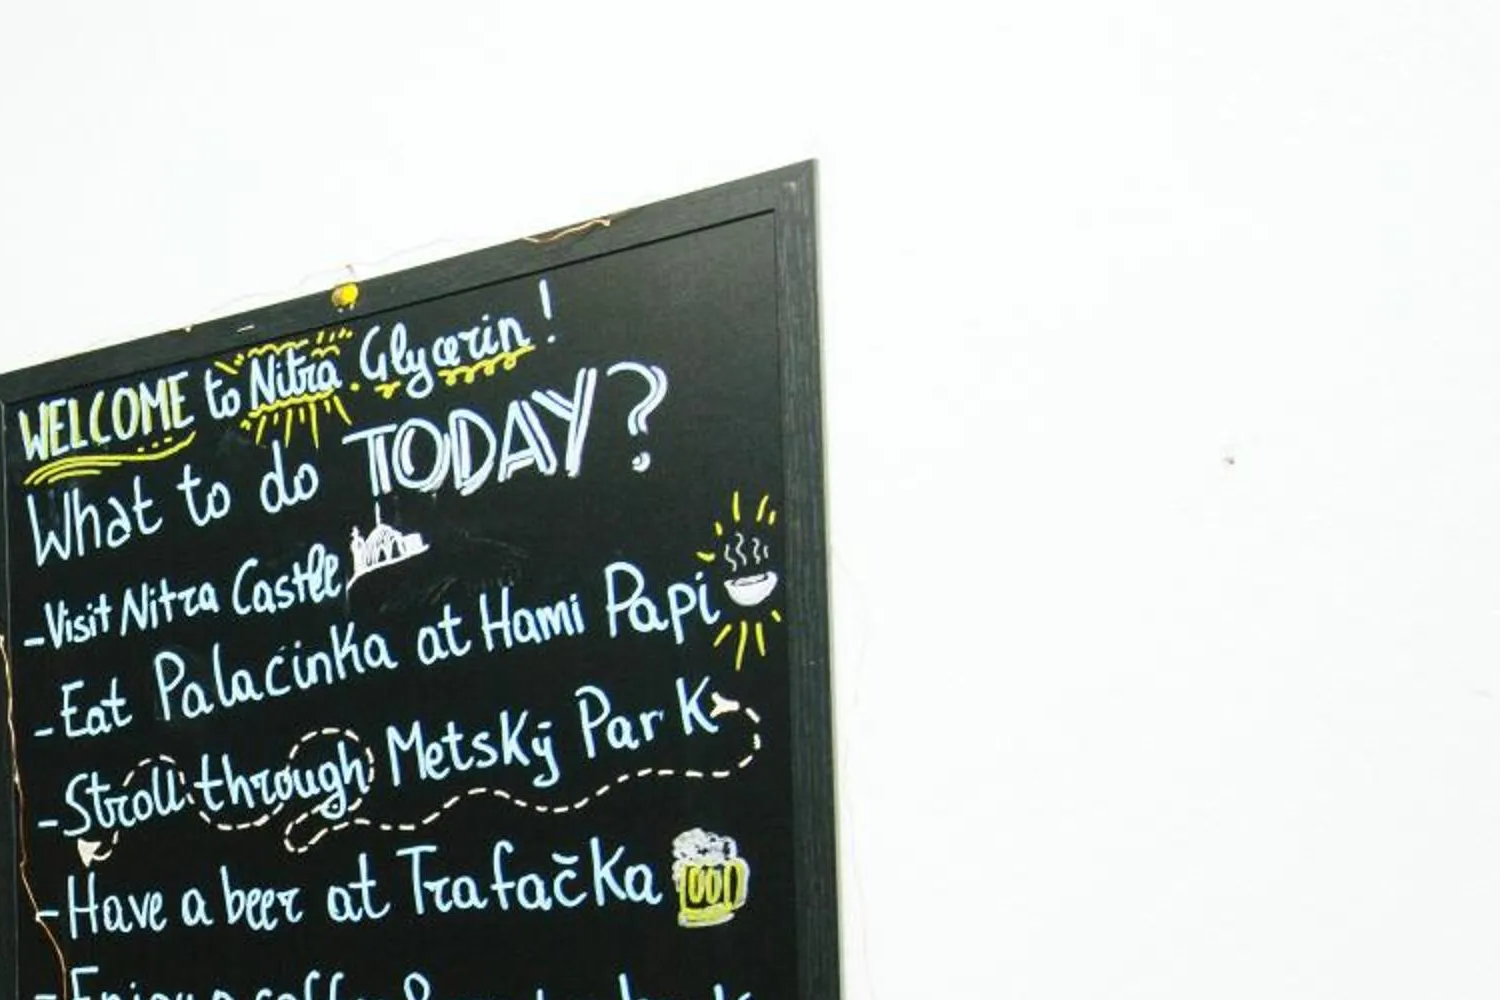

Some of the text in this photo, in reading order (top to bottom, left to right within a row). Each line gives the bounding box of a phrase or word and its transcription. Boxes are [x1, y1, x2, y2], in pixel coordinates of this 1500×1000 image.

[18, 371, 196, 461] WELCOME
[204, 367, 241, 420] to
[250, 347, 343, 411] Nitra
[27, 475, 163, 567] What
[177, 464, 231, 527] to
[260, 440, 320, 513] do
[120, 578, 219, 637] Nitra
[233, 543, 342, 616] Castle
[416, 604, 472, 666] at
[479, 586, 586, 652] Hami
[604, 561, 720, 645] Papi
[193, 740, 370, 820] through
[180, 886, 214, 926] a
[219, 865, 304, 931] beer
[326, 852, 392, 923] at
